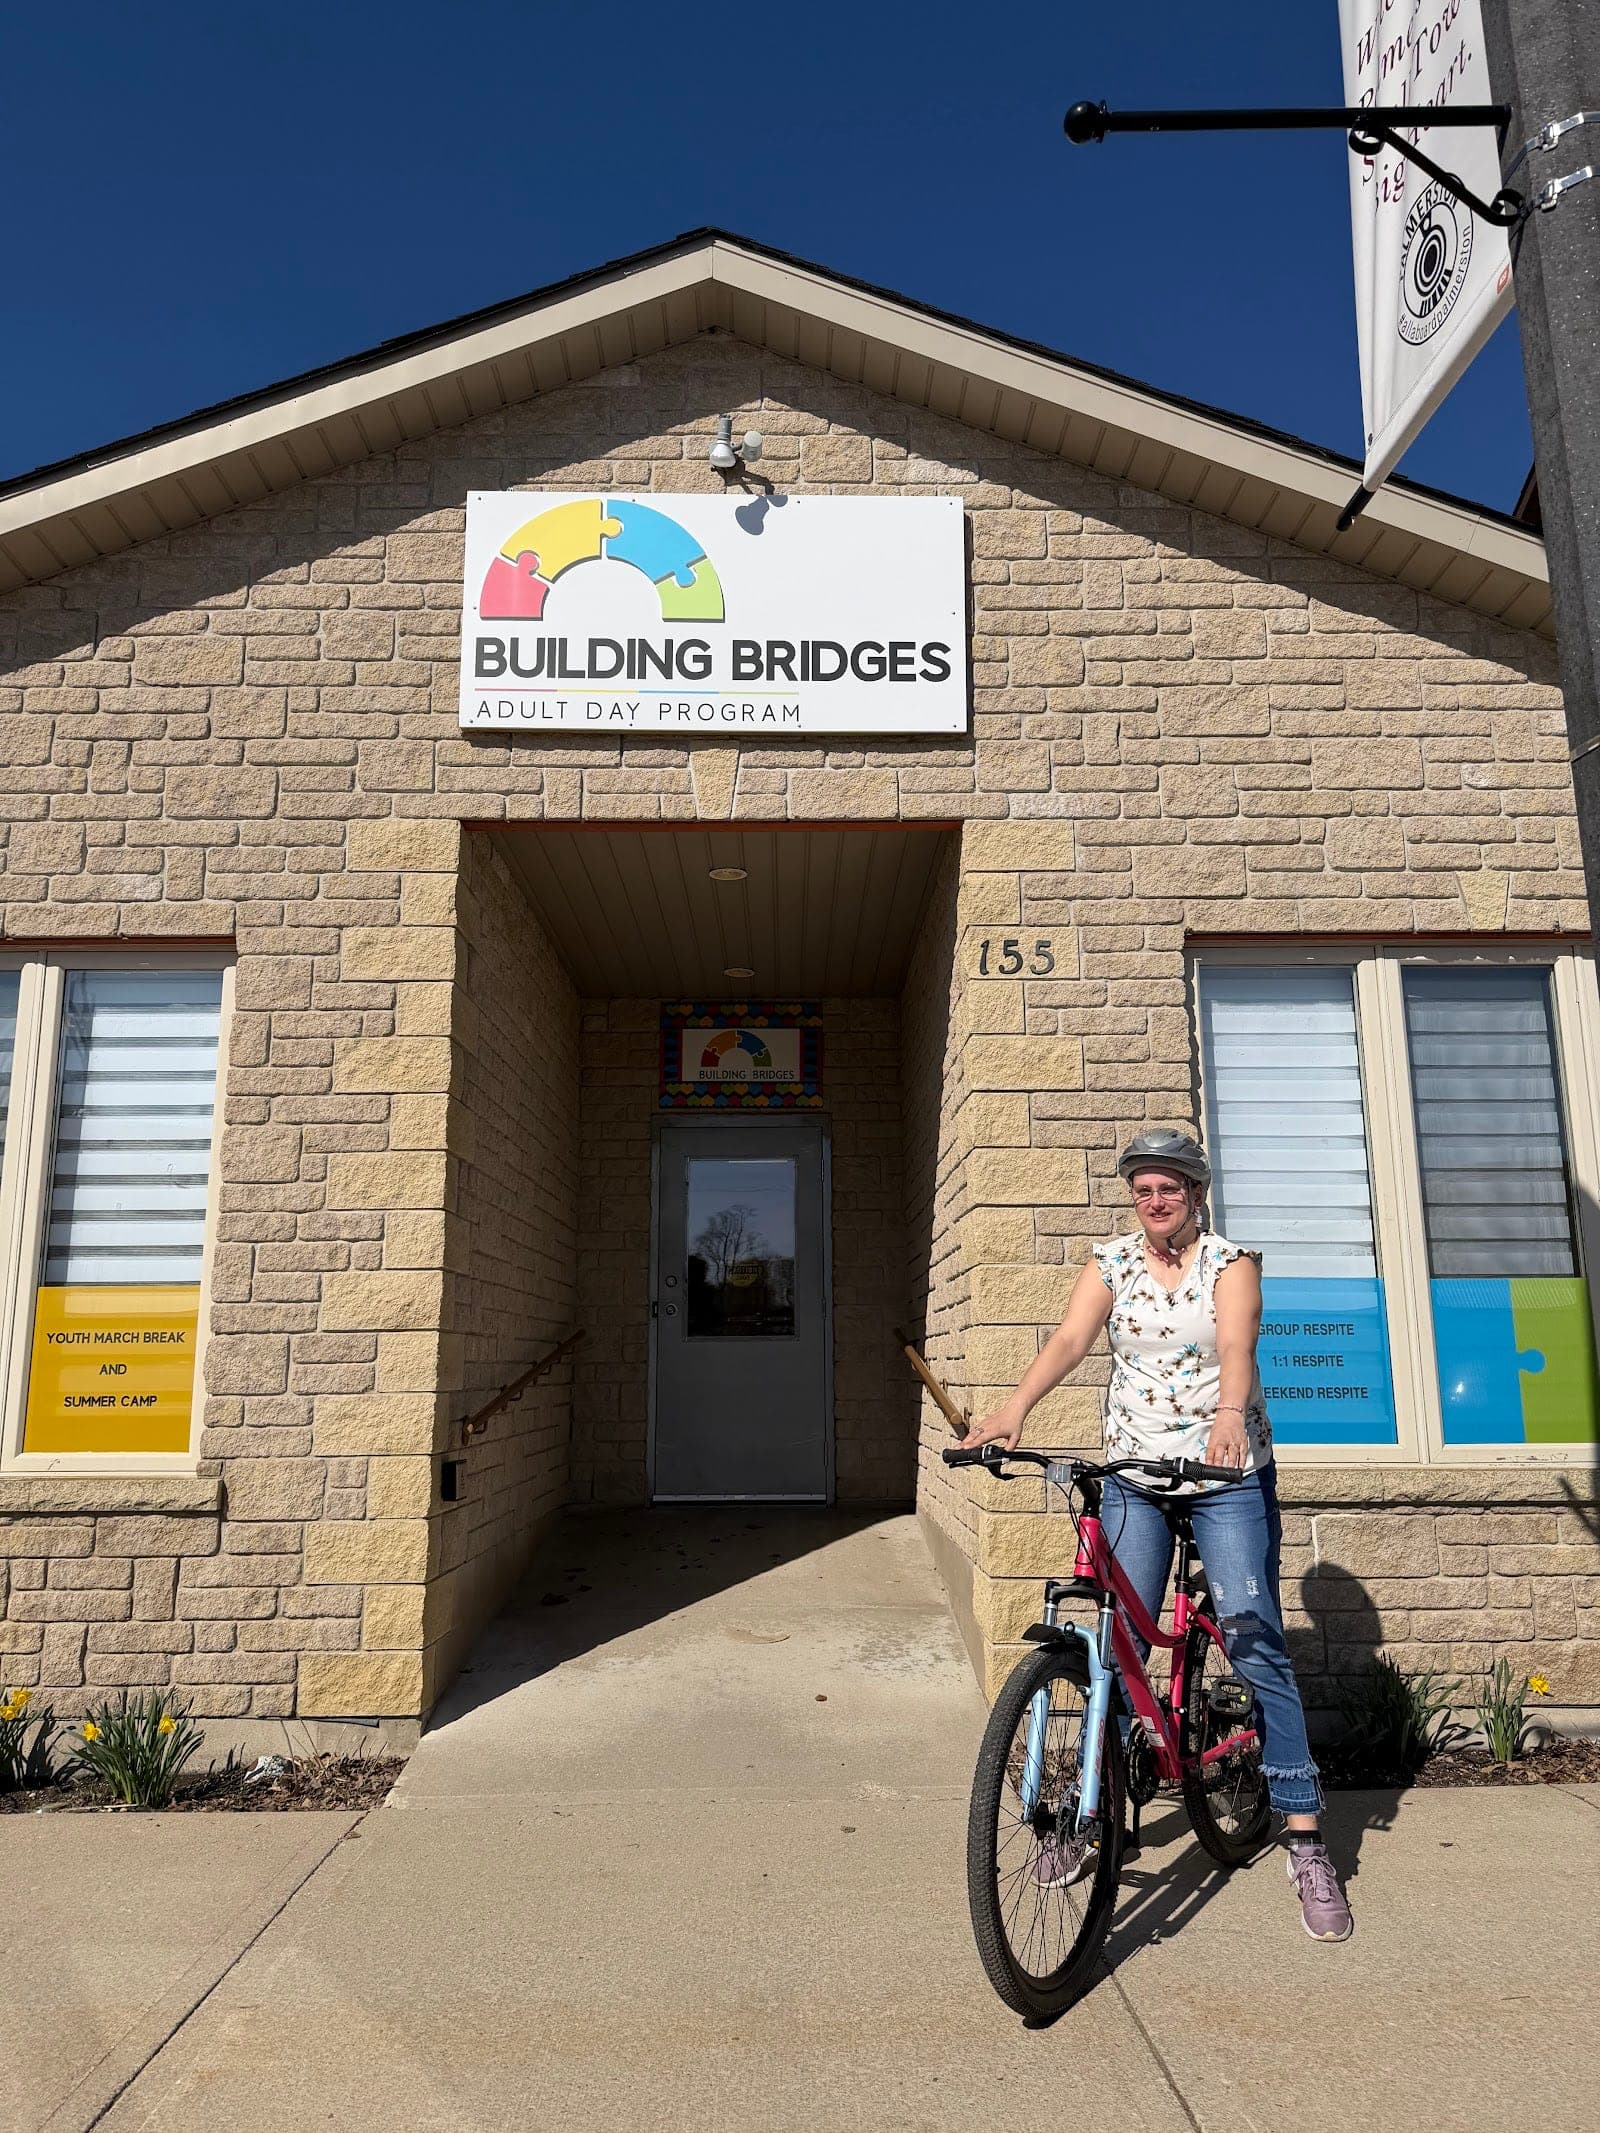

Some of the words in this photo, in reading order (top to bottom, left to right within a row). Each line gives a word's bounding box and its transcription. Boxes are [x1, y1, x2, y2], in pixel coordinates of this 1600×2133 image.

[1412, 0, 1460, 82] Tow
[475, 637, 713, 680] BUILDING
[732, 639, 951, 682] BRIDGES
[477, 700, 568, 719] ADULT
[586, 702, 640, 720] DAY
[659, 702, 800, 722] PROGRAM
[980, 939, 1055, 975] 155
[699, 1070, 746, 1080] BUILDING
[752, 1070, 794, 1080] BRIDGES
[1259, 1323, 1300, 1335] GROUP
[1303, 1323, 1355, 1335] RESPITE
[46, 1332, 90, 1344] YOUTH
[94, 1332, 139, 1343] MARCH
[143, 1331, 186, 1343] BREAK
[1272, 1355, 1289, 1367] 1:1
[1292, 1355, 1344, 1367] RESPITE
[99, 1364, 127, 1375] AND
[1263, 1387, 1314, 1399] EEKEND
[1317, 1387, 1369, 1399] RESPITE
[63, 1396, 116, 1408] SUMMER
[120, 1396, 157, 1407] CAMP
